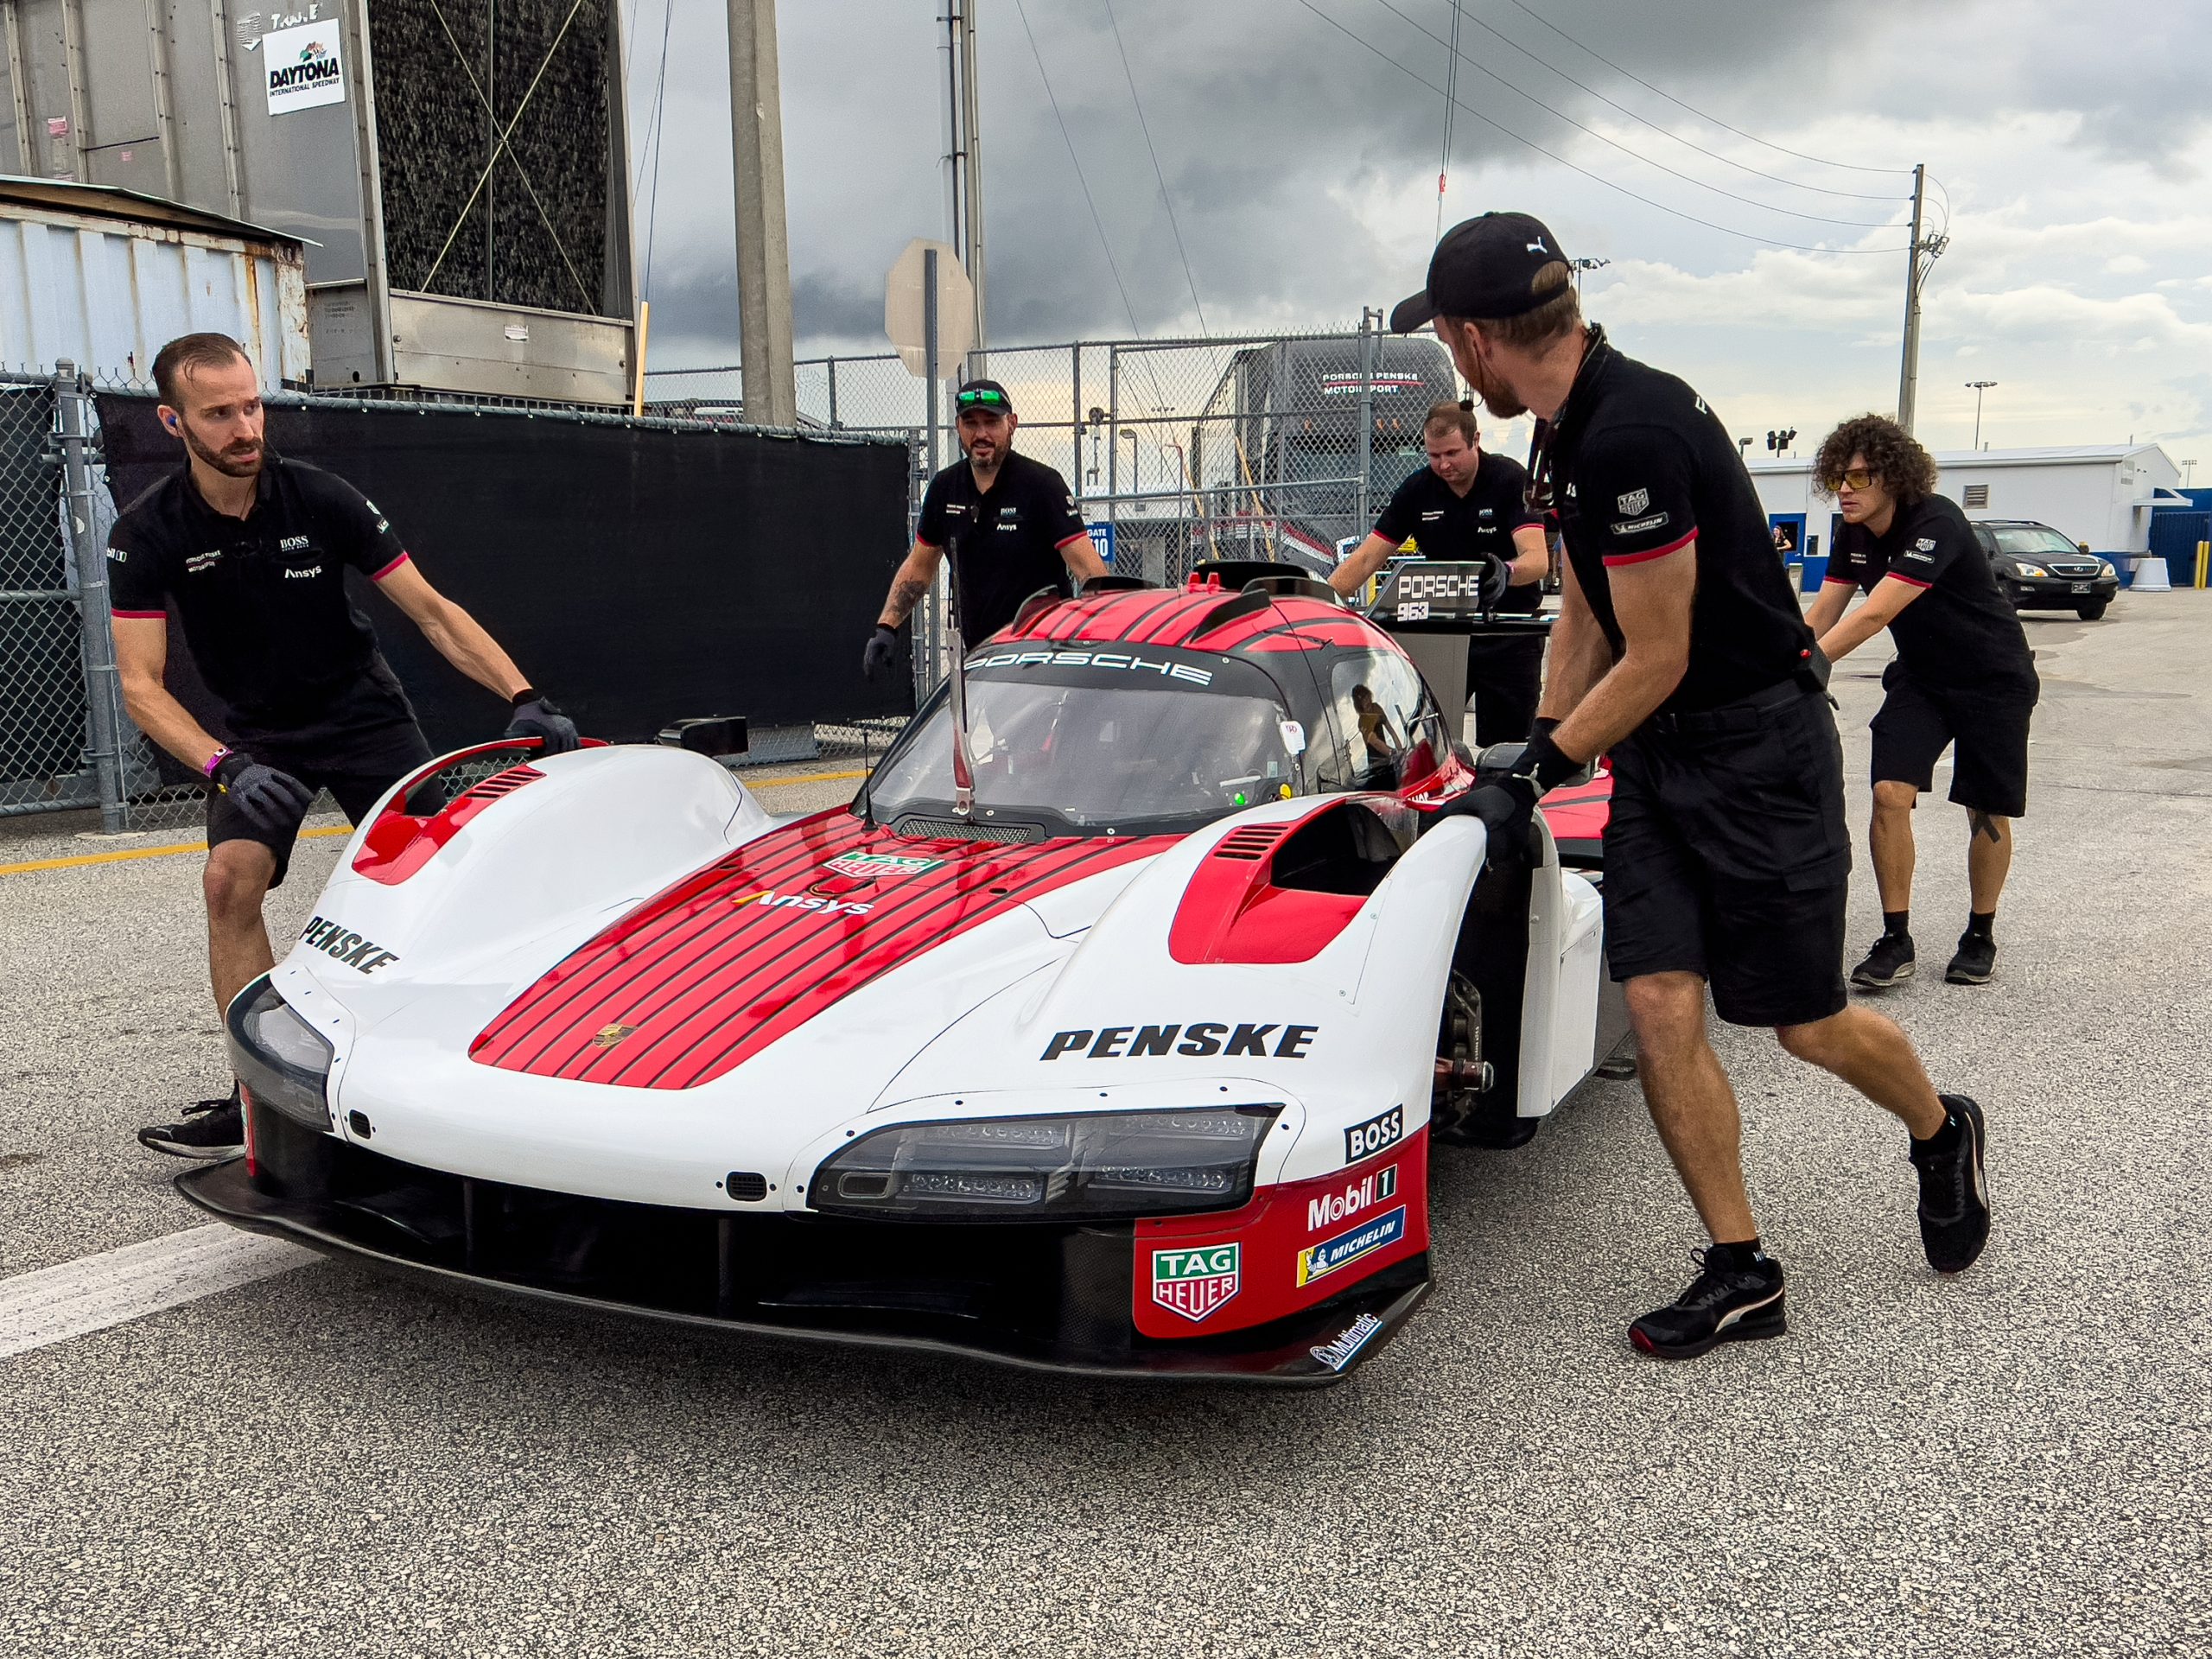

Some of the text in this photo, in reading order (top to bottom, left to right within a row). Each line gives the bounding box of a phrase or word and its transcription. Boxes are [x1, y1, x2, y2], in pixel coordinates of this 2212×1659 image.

[270, 57, 339, 89] DAYTONA
[269, 77, 340, 98] INTERNATIONAL SPEEDWAY
[1376, 372, 1418, 380] PENSKE
[1620, 493, 1644, 505] TAG
[280, 535, 309, 550] BOSS
[1087, 528, 1107, 537] GATE
[284, 565, 322, 579] Ansys
[1398, 575, 1479, 600] PORSCHE
[1397, 601, 1429, 622] 963
[963, 652, 1212, 686] PORSCHE
[831, 861, 921, 875] HEUER
[850, 853, 932, 867] TAG
[732, 890, 874, 915] Ansys
[298, 916, 400, 975] PENSKE
[1039, 1022, 1319, 1061] PENSKE
[1350, 1111, 1399, 1159] BOSS
[1307, 1174, 1373, 1232] Mobil
[1330, 1219, 1396, 1262] MICHELIN
[1160, 1249, 1231, 1276] TAG
[1159, 1276, 1234, 1315] HEUER
[1326, 1313, 1379, 1357] Multimatic
